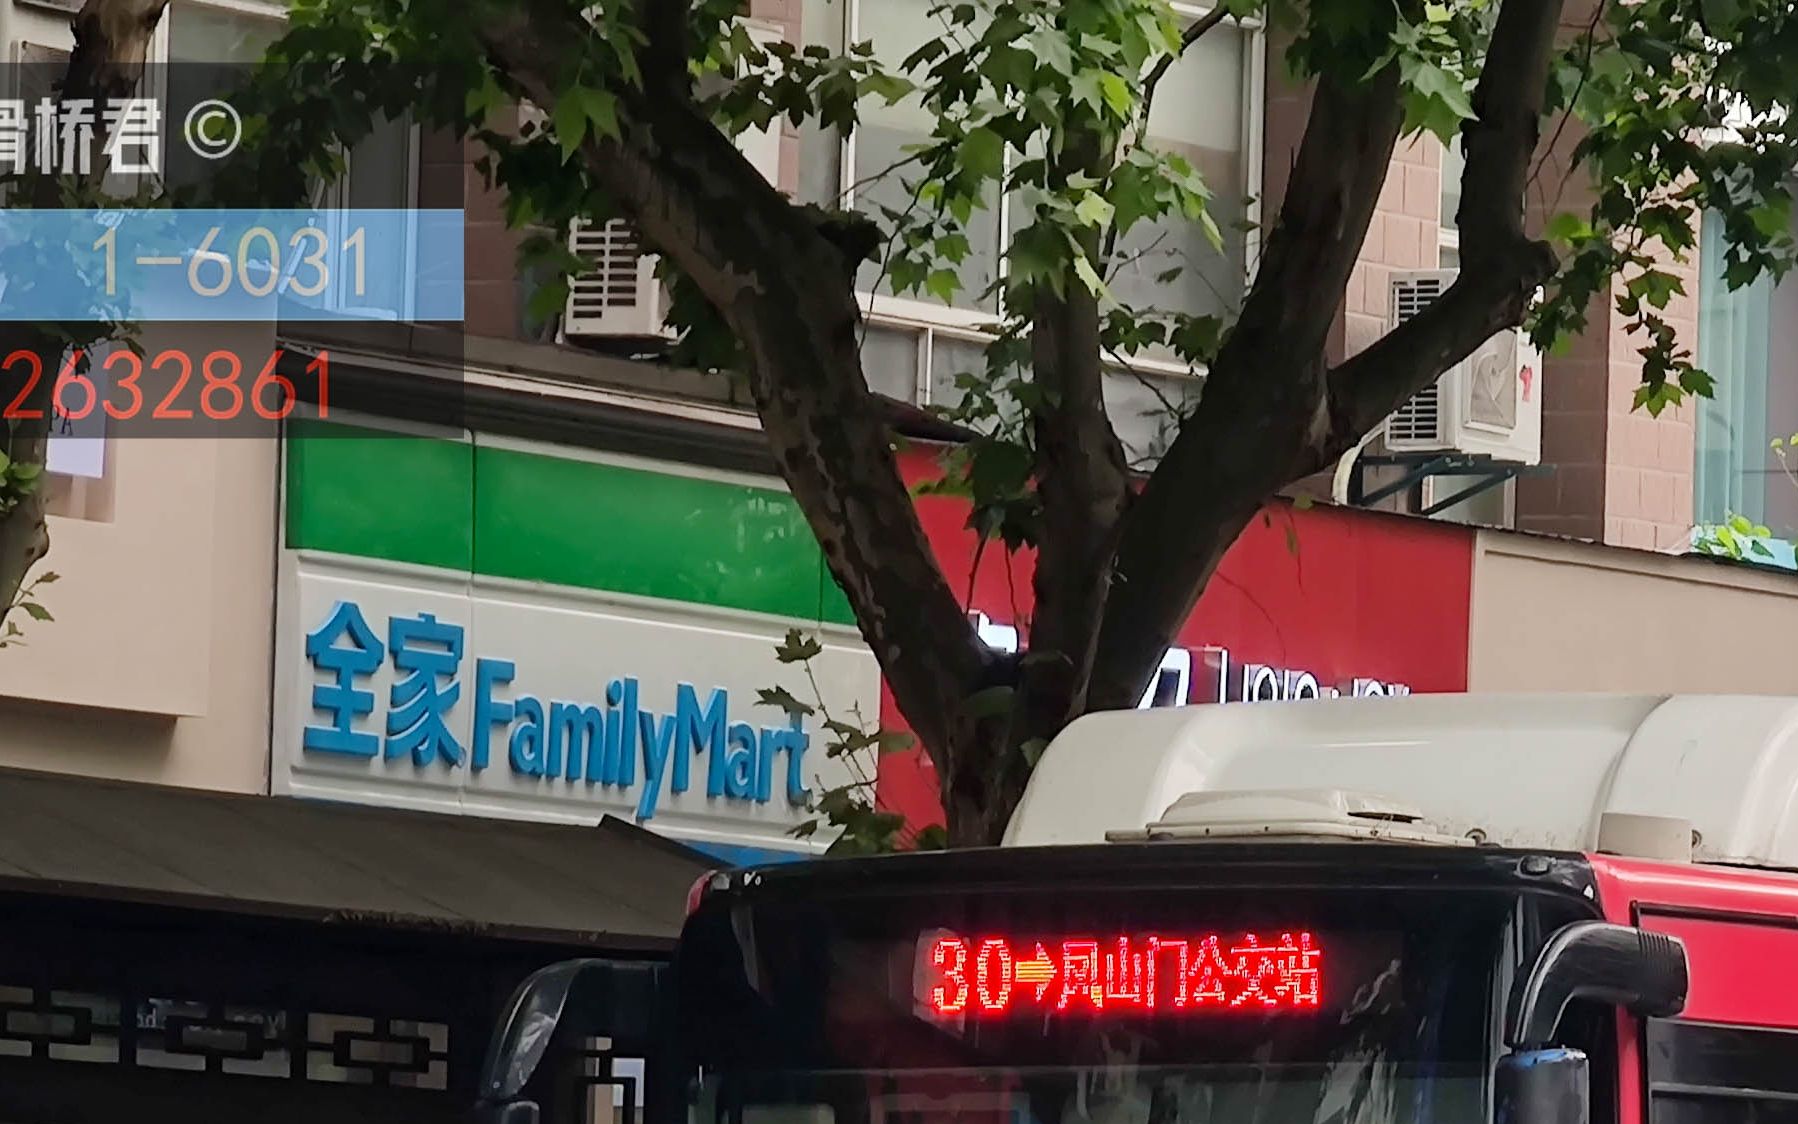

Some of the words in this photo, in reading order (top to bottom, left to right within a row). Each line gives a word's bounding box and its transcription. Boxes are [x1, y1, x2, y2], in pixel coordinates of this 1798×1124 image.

[303, 600, 466, 767] 全家
[474, 658, 812, 820] FamilyMart
[934, 938, 1012, 1010] 30
